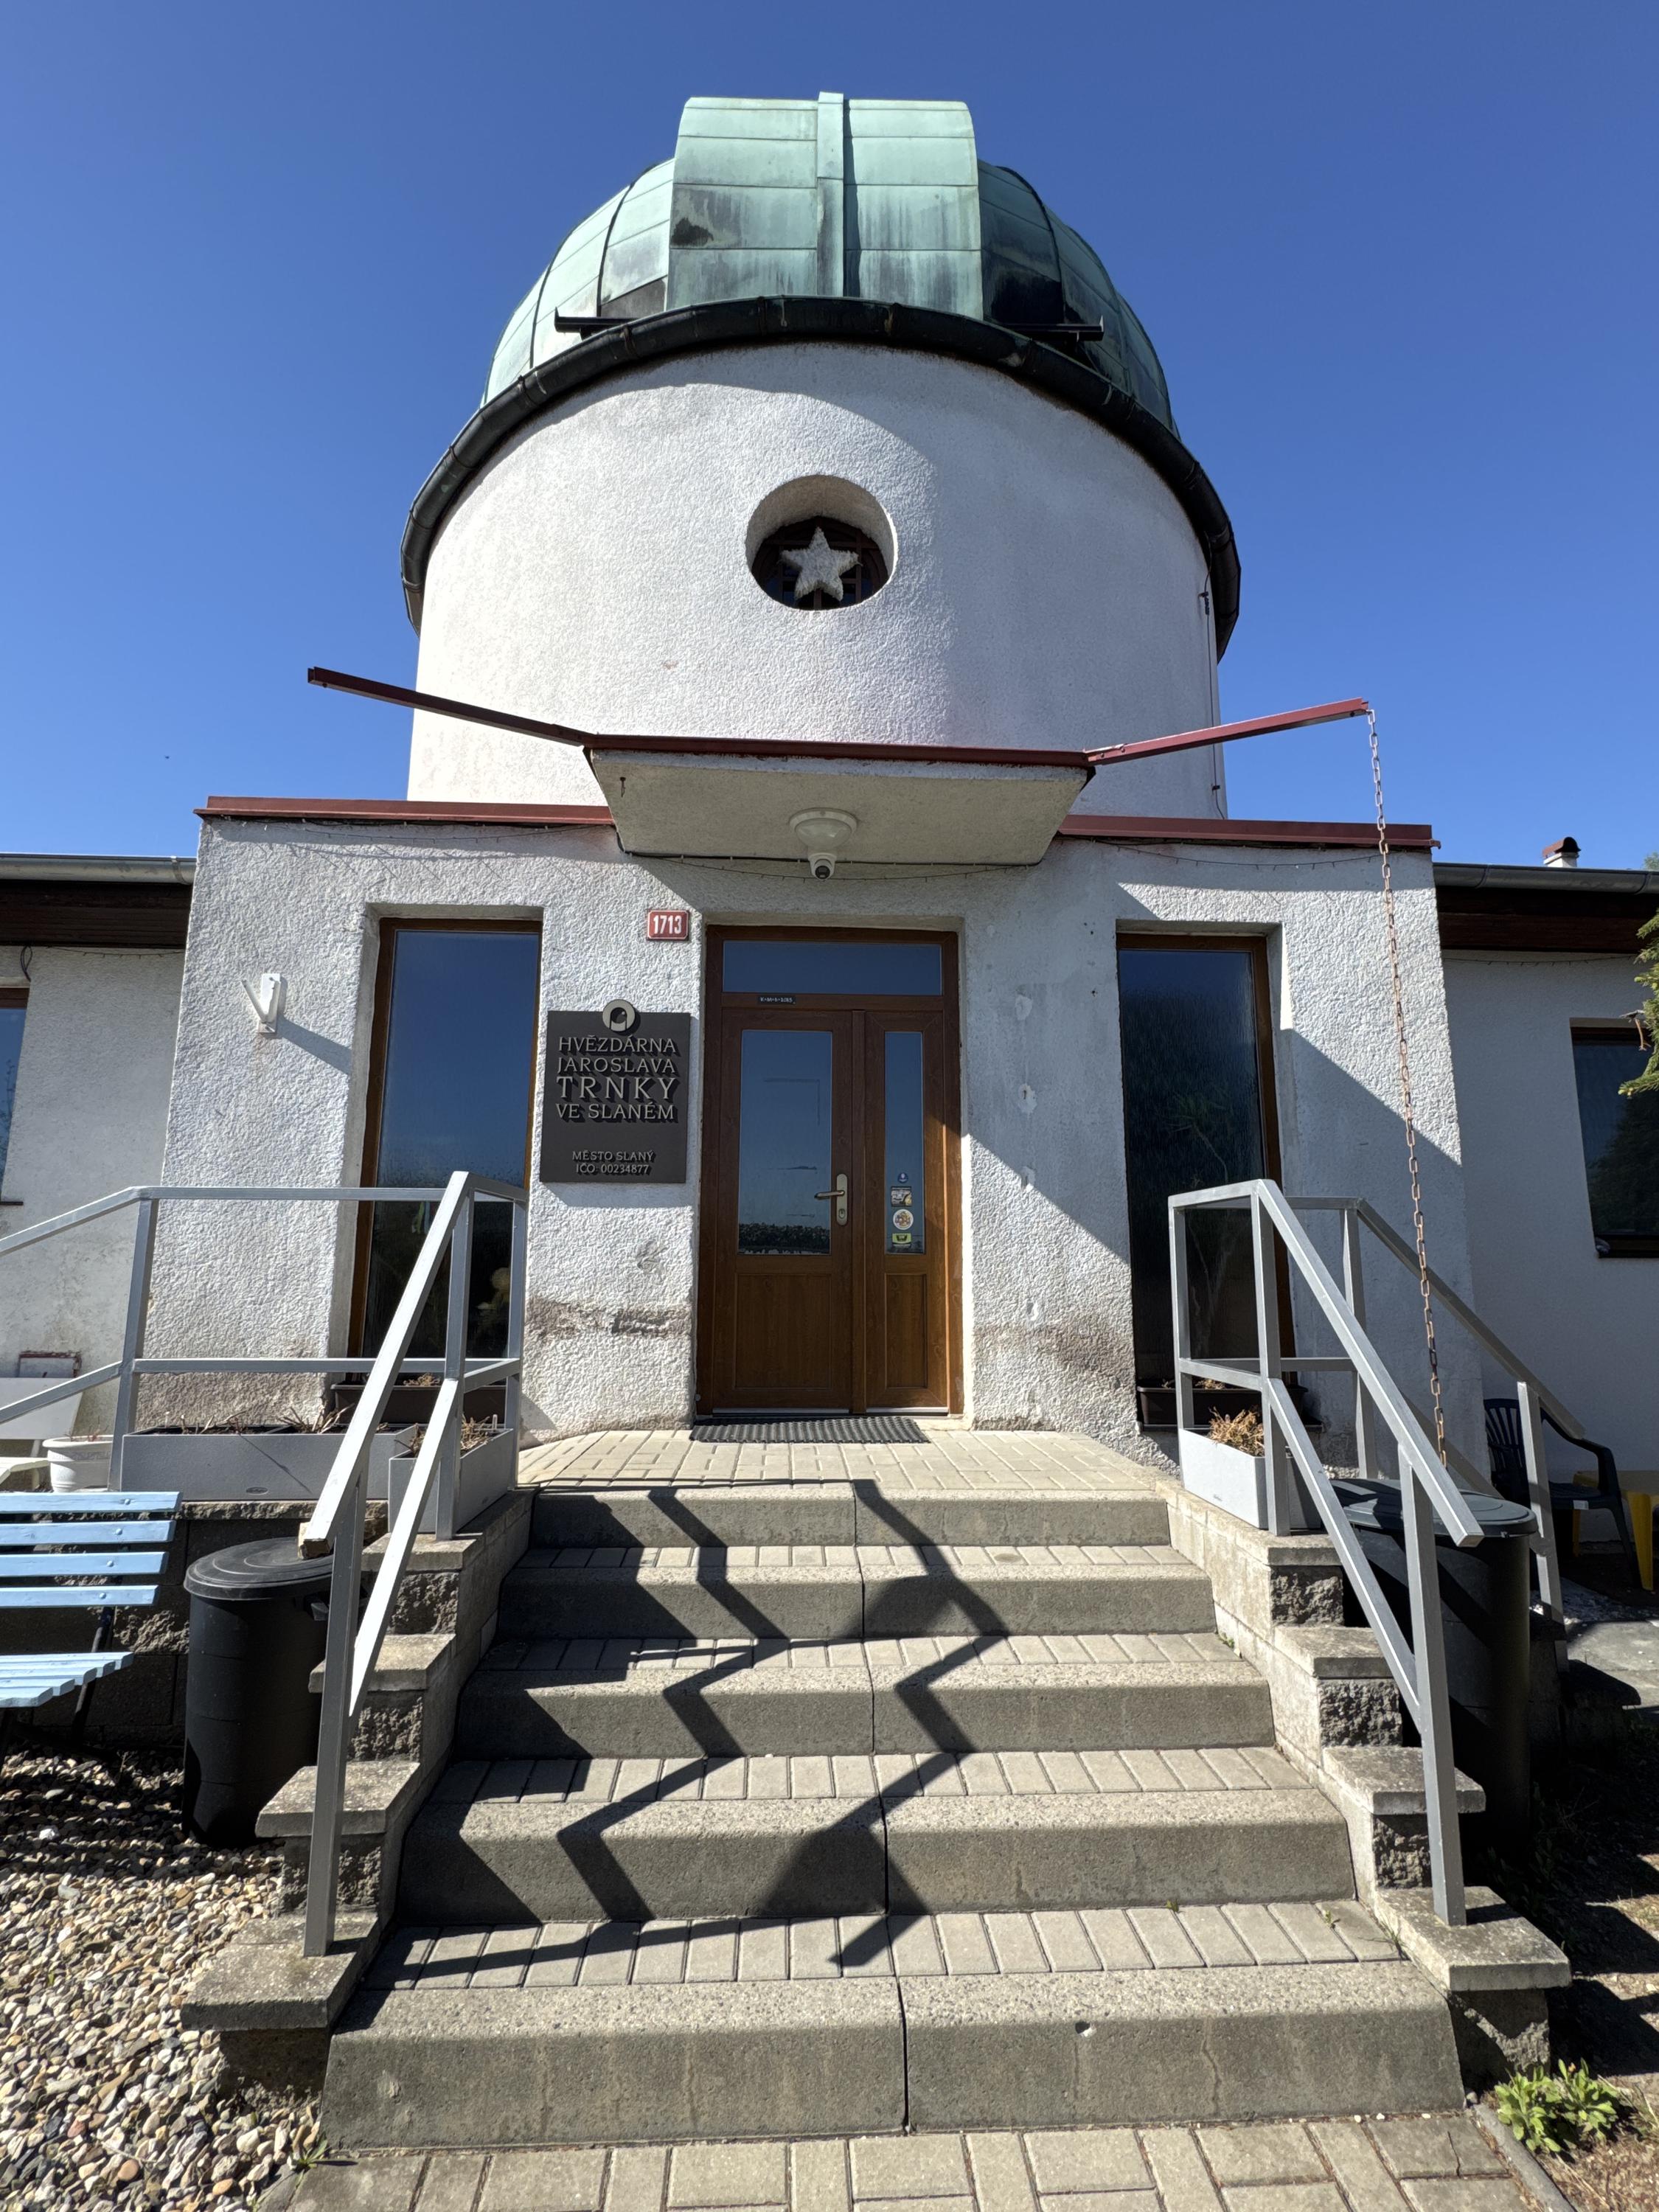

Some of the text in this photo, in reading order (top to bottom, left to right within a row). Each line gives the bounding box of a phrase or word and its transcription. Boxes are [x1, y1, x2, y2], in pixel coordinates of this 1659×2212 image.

[653, 915, 682, 934] 1713
[558, 1035, 676, 1052] HVĚZDÁRNA
[557, 1057, 675, 1074] JAROSLAVA
[556, 1076, 676, 1099] TRNKY
[556, 1102, 674, 1119] VE SLANÉM
[572, 1150, 653, 1161] MĚSTO SLANÝ
[601, 1164, 650, 1173] 00234877
